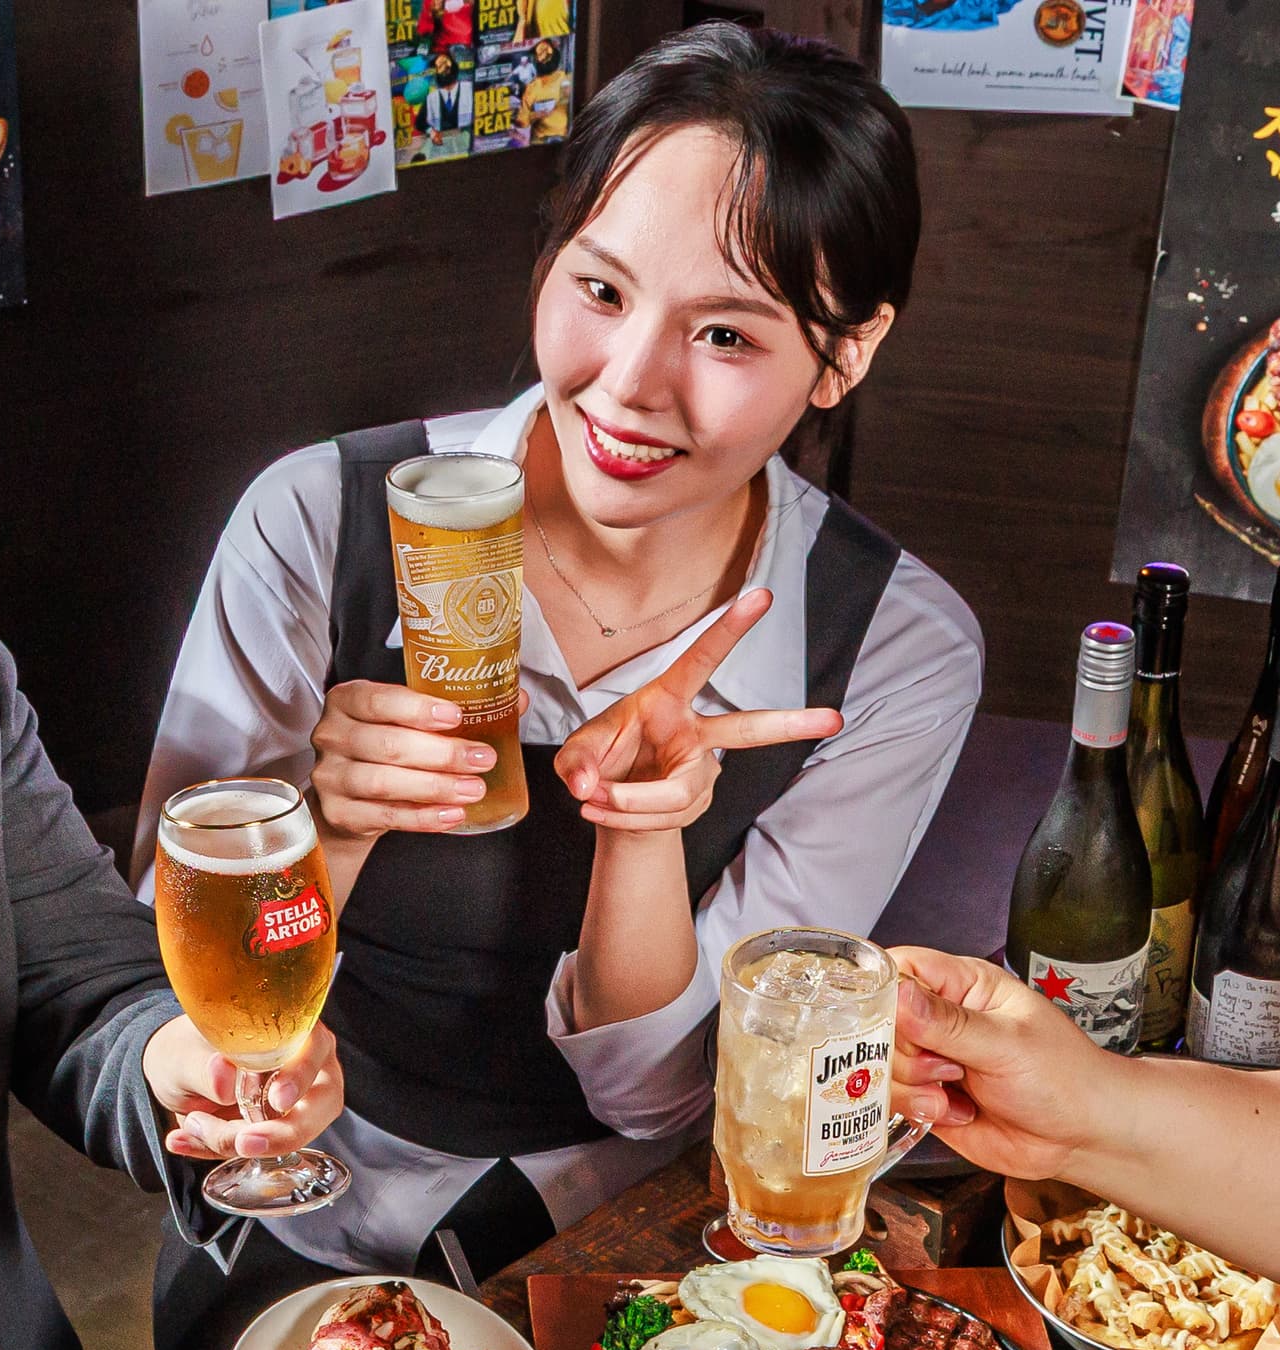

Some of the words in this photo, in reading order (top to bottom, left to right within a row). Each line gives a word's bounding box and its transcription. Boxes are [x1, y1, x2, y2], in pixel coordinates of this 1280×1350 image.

[479, 7, 516, 31] PEAT
[474, 86, 511, 116] BIG
[474, 112, 513, 137] PEAT
[415, 649, 520, 682] Budweis
[463, 708, 513, 725] SER-BUSCH
[263, 896, 320, 928] STELLA
[265, 912, 322, 944] ARTOIS
[816, 1050, 854, 1085] JIM
[855, 1041, 890, 1065] BEAM
[821, 1104, 883, 1141] BOURBON
[842, 1131, 869, 1146] WHISKEY
